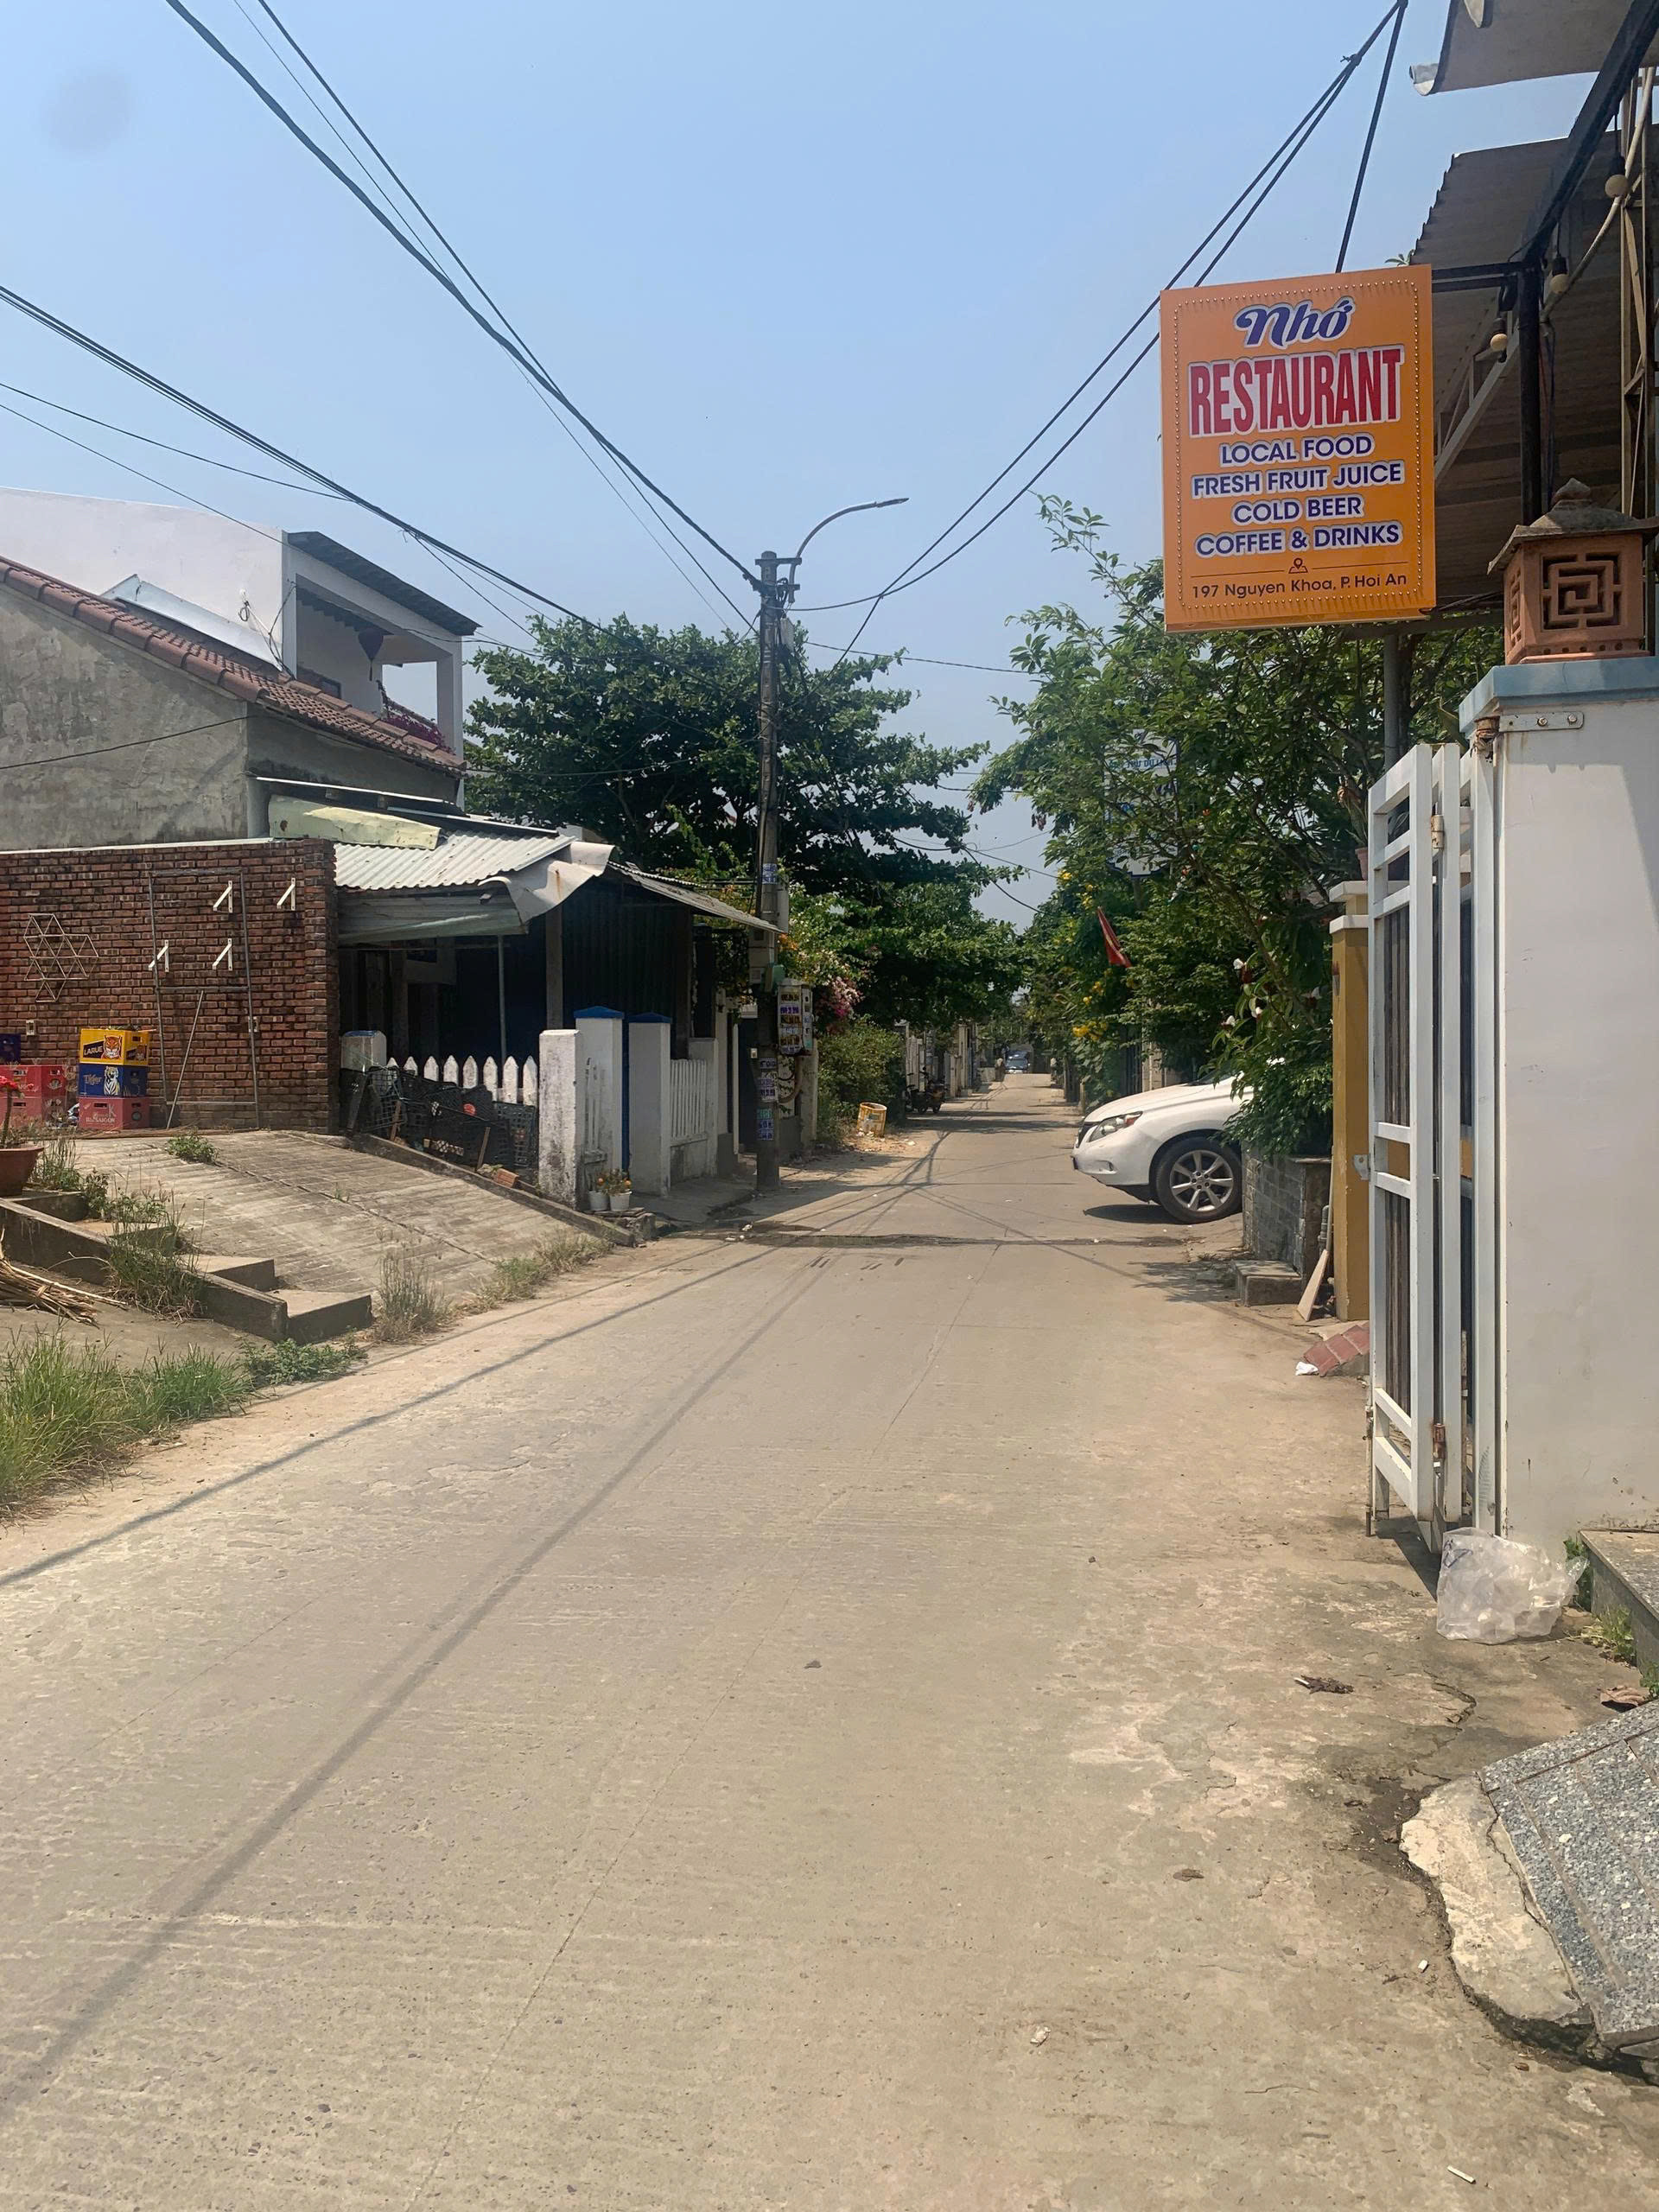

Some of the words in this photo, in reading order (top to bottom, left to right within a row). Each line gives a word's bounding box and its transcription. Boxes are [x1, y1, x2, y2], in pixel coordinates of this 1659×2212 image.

[1188, 347, 1402, 435] RESTAURANT
[1221, 442, 1296, 465] LOCAL
[1304, 435, 1373, 458] FOOD
[1193, 474, 1260, 497] FRESH
[1268, 469, 1329, 490] FRUIT
[1333, 462, 1402, 486] JUICE
[1234, 500, 1300, 524] COLD
[1306, 497, 1363, 518] BEER
[1196, 532, 1283, 556] COFFEE
[1290, 530, 1308, 549] &
[1313, 524, 1400, 548] DRINKS
[1192, 584, 1219, 599] 197
[1224, 583, 1286, 600] Nguyen
[1290, 579, 1337, 593] Khoa,
[1354, 575, 1381, 588] Hoi
[1384, 574, 1407, 587] An
[84, 1046, 103, 1055] LARUE
